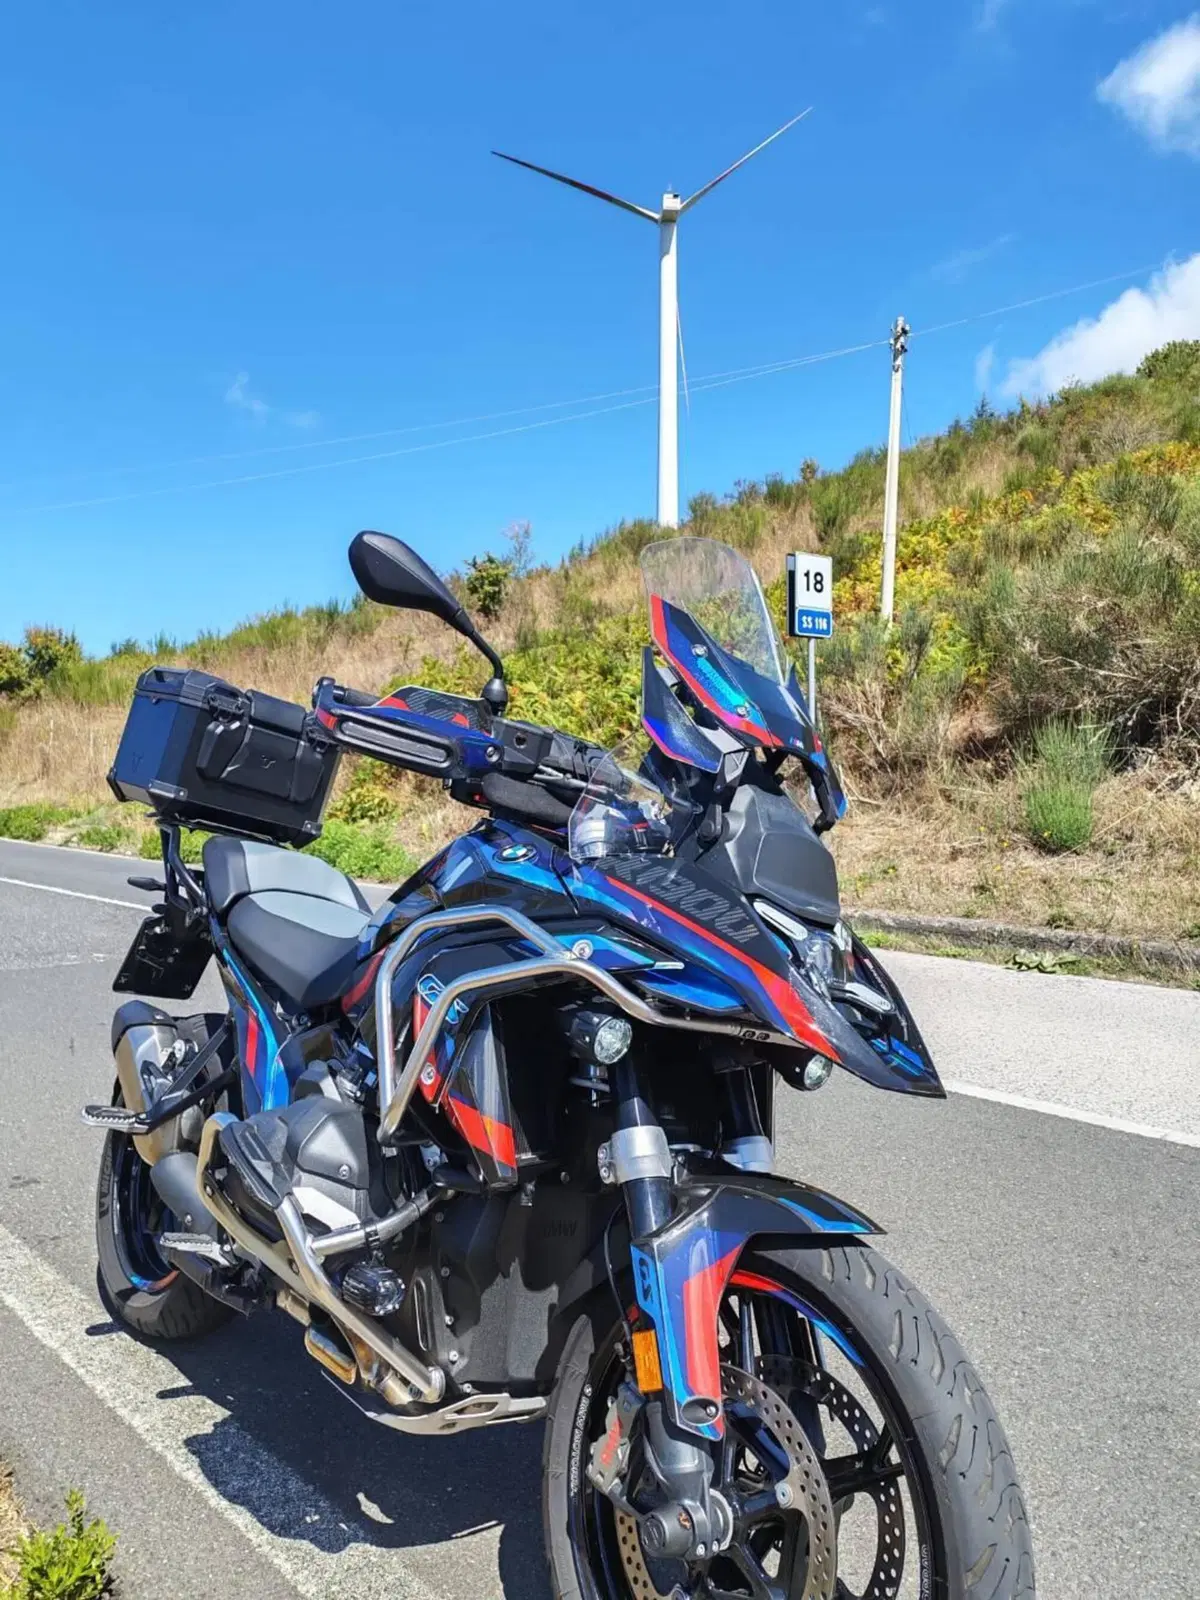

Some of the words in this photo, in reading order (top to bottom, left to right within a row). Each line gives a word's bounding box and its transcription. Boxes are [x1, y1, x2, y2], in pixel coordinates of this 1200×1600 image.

[804, 569, 824, 593] 18
[802, 615, 813, 629] SS
[815, 616, 828, 631] 116
